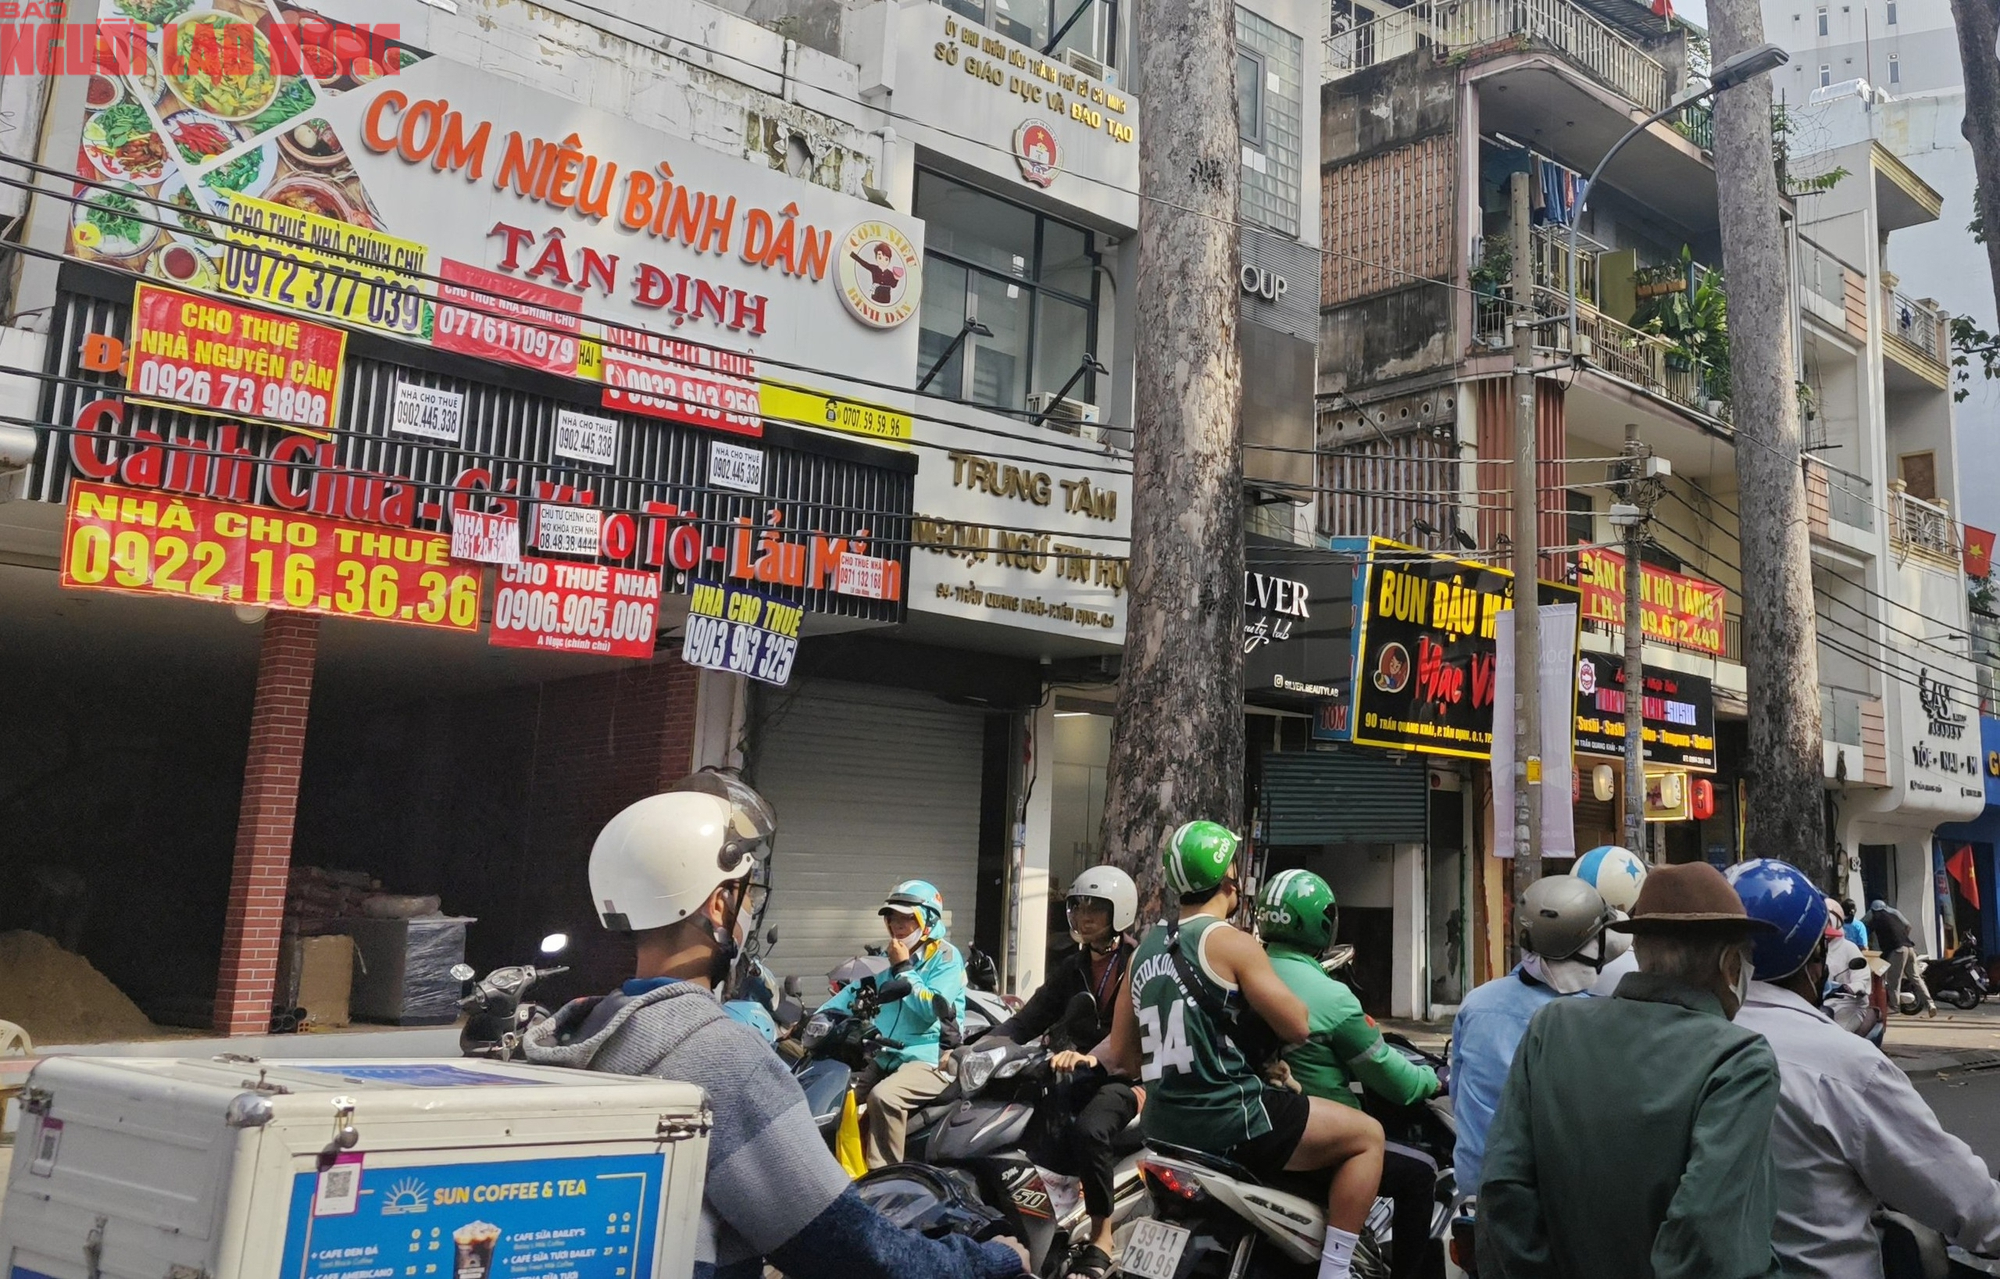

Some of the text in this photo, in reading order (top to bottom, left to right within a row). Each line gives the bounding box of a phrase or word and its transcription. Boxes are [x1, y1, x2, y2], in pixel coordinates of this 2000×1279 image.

[962, 27, 980, 48] BAN
[1030, 55, 1057, 83] THÀNH
[965, 56, 1004, 87] GIÁO
[1010, 76, 1042, 103] DỤC
[1046, 92, 1065, 115] VÀ
[1070, 102, 1101, 129] ĐÀO
[1106, 117, 1134, 143] TẠO
[362, 90, 832, 281] CƠM NIÊU BÌNH DÂN
[231, 203, 424, 281] CHO THUÊ NHÀ CHÍNH CHỦ
[224, 240, 420, 331] 0972 377 039
[488, 222, 768, 335] TÂN ĐỊNH
[181, 303, 300, 350] CHO THUÊ
[439, 306, 574, 364] 0776110979
[141, 328, 188, 360] NHÀ
[194, 340, 286, 380] NGUYÊN
[291, 358, 334, 392] CĂN
[606, 324, 756, 386] NHÀ CHO THUÊ
[139, 360, 326, 428] 0926 73 9898
[401, 388, 458, 409] NHÀ CHO THUÊ
[626, 370, 762, 429] 0932 643 250
[397, 400, 458, 434] 0902.445.338
[561, 415, 613, 433] NHÀ CHO THUÊ
[558, 426, 613, 458] 0902.445.338
[715, 445, 760, 463] NHÀ CHO THUÊ
[712, 456, 760, 486] 0902.445.338
[948, 452, 1117, 521] TRUNG TÂM
[71, 399, 807, 588] Canh Chua Lẩu
[76, 491, 450, 566] NHÀ CHO THUÊ
[454, 512, 519, 542] NHÀ BÁN
[565, 508, 584, 523] CHÍNH
[571, 524, 584, 534] XEM
[539, 532, 598, 553] 08.48.38.4444
[912, 512, 990, 568] NGOẠI
[1054, 543, 1091, 583] TIN
[69, 525, 478, 627] 0922.16.36.36
[841, 555, 854, 565] CHO
[501, 562, 659, 598] CHO THUÊ NHÀ
[840, 567, 855, 585] 0971
[857, 571, 868, 587] 132
[1581, 552, 1616, 592] BÁN
[1654, 576, 1673, 615] HỘ
[1676, 579, 1714, 622] TẦNG
[495, 588, 654, 643] 0906.905.006
[690, 582, 804, 638] NHÀ CHO THUÊ
[1379, 563, 1428, 625] BÚN
[1432, 574, 1477, 643] ĐẬU
[1590, 593, 1618, 622] LH:
[537, 634, 544, 645] A
[1272, 619, 1292, 640] lab
[682, 615, 796, 682] 0903 963 325
[1284, 679, 1339, 697] SILVER.BEAUTYLAB
[1365, 712, 1378, 728] 90
[1398, 721, 1419, 735] QUANG
[1577, 716, 1600, 733] Sushi
[1213, 837, 1231, 864] Grab
[1851, 856, 1862, 871] 82
[1257, 903, 1291, 925] Grab
[1138, 999, 1195, 1082] 34
[433, 1179, 587, 1206] SUN COFFEE & TEA
[1011, 1188, 1047, 1208] 50
[514, 1231, 533, 1242] CAFE
[319, 1248, 343, 1260] CAFE
[511, 1254, 531, 1265] CAFE
[1122, 1245, 1174, 1278] 780.96
